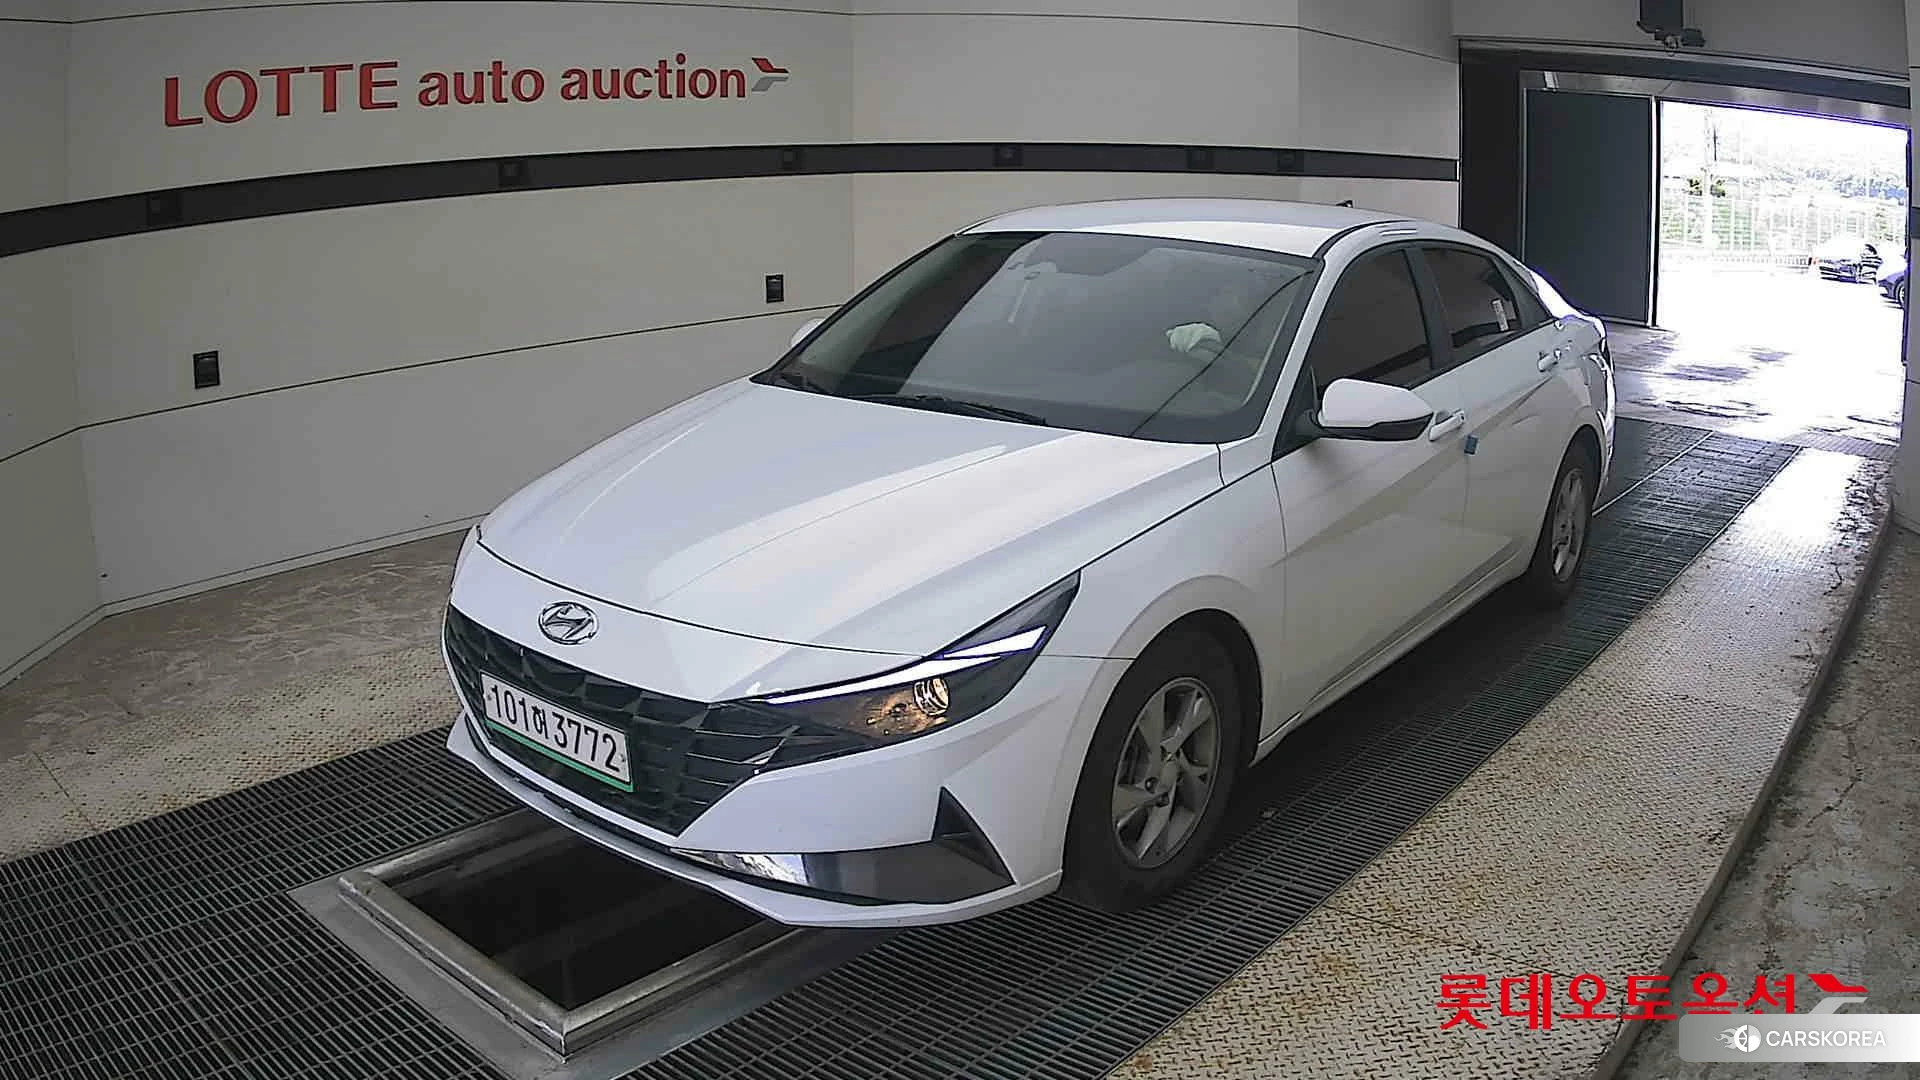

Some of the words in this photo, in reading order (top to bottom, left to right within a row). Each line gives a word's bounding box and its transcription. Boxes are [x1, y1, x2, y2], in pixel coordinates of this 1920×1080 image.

[165, 60, 399, 127] LOTTE
[418, 60, 545, 107] auto
[560, 53, 747, 100] auction
[491, 684, 620, 773] 101허3772
